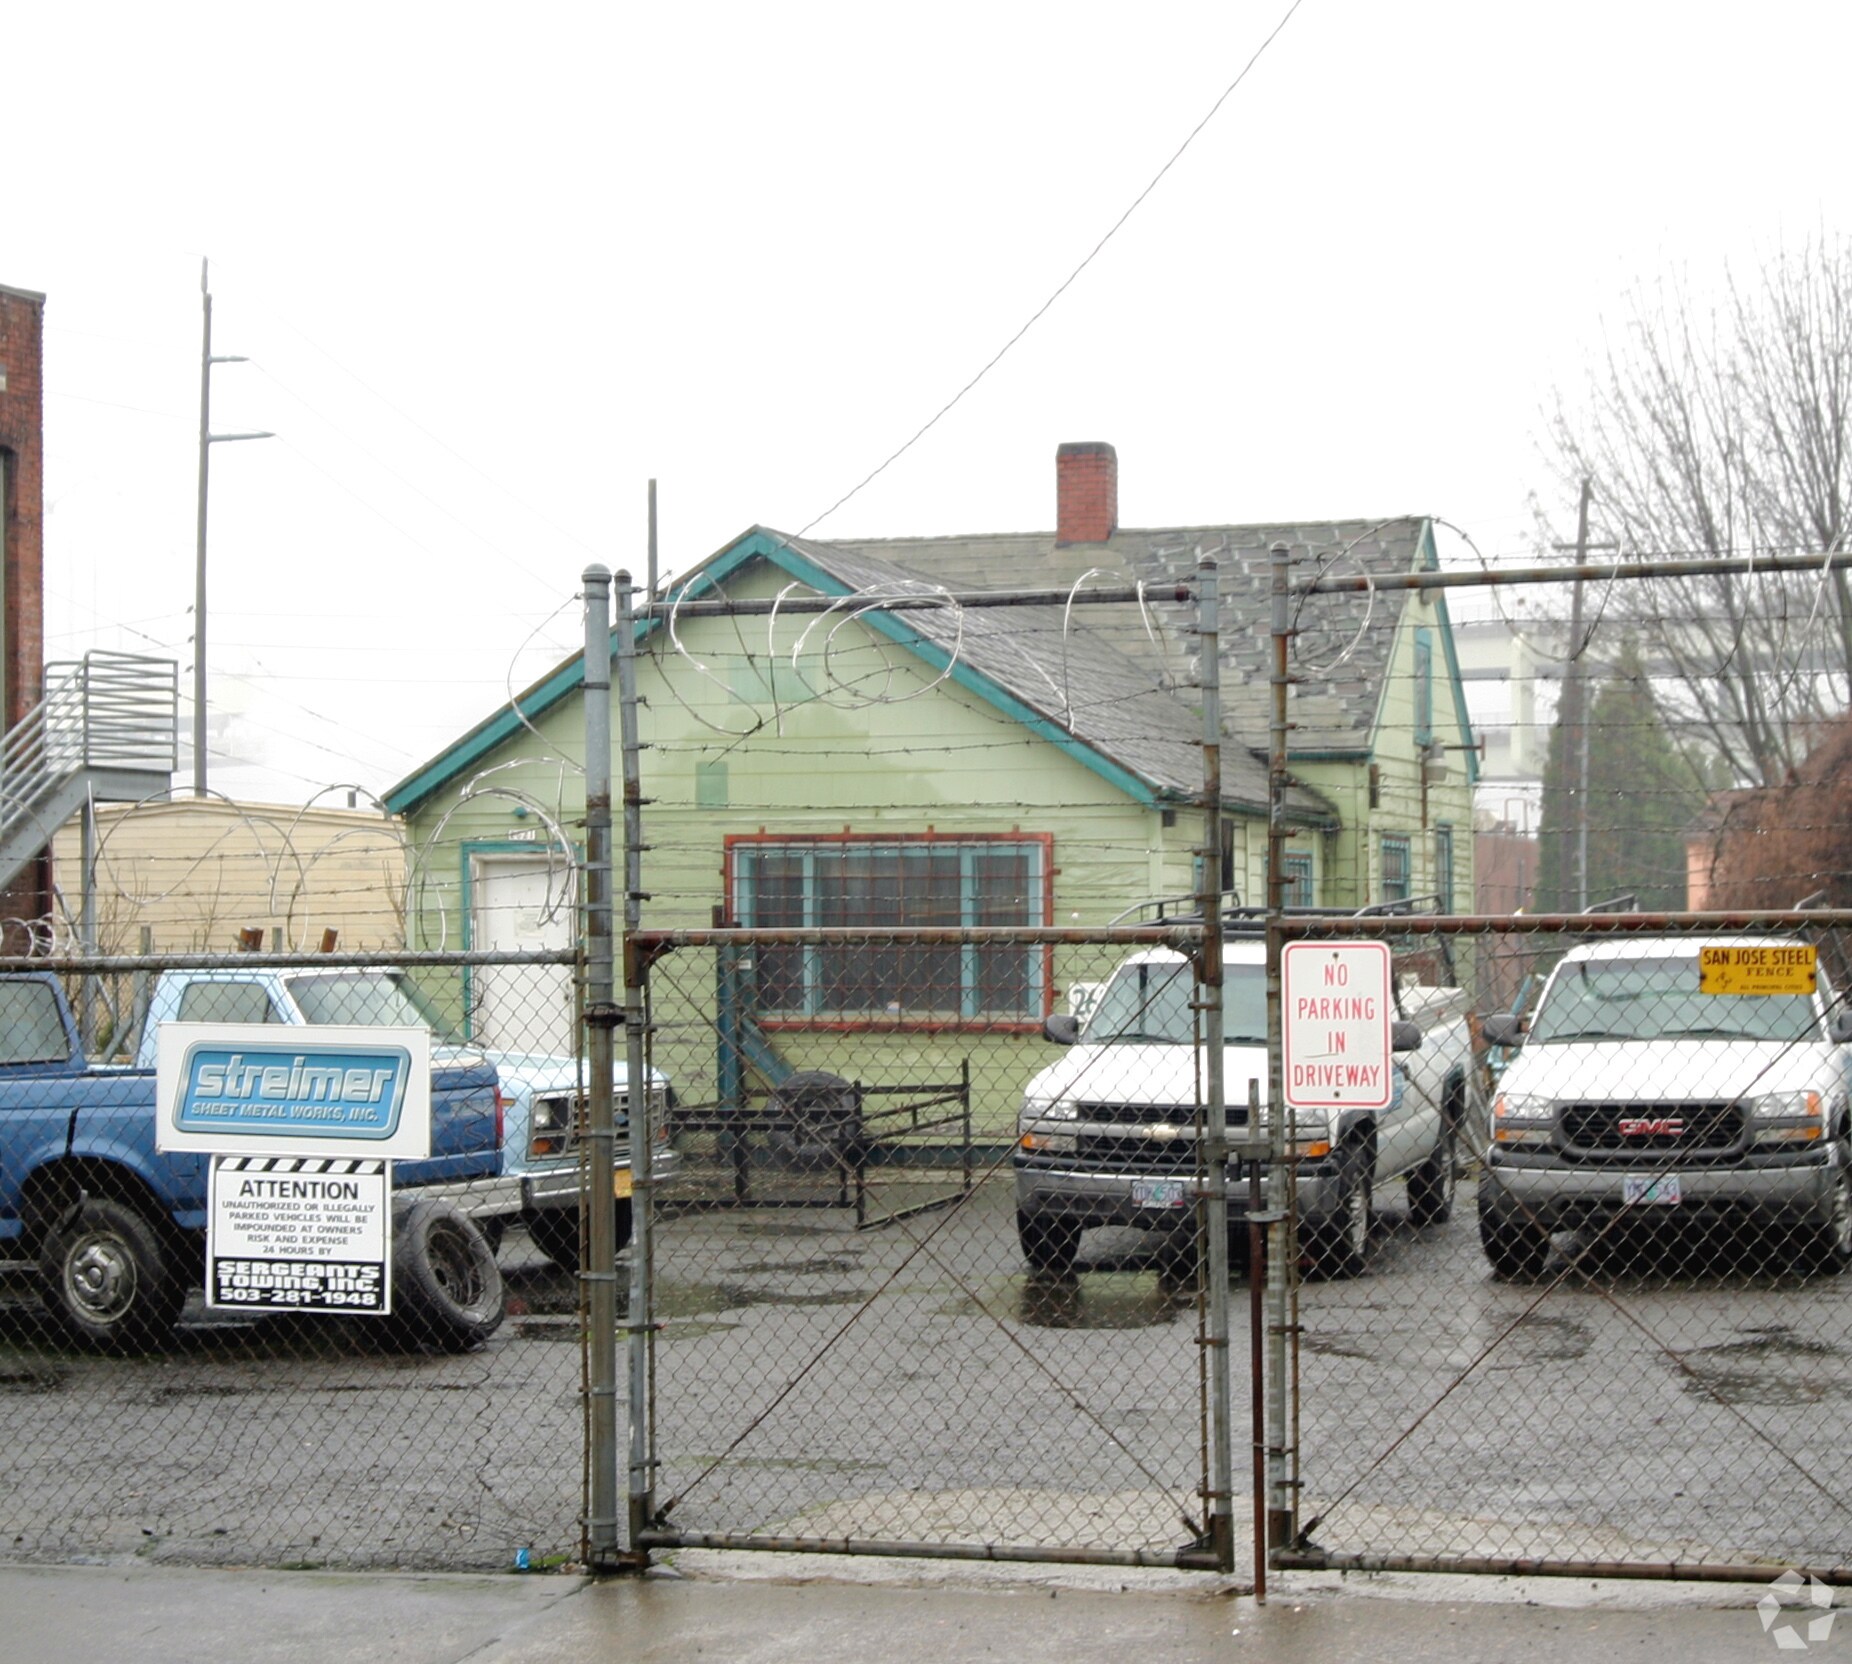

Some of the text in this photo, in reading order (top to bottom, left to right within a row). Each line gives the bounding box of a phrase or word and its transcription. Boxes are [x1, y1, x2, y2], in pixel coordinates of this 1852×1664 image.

[1703, 950, 1812, 966] SAN JOSE STEEL
[1324, 964, 1348, 986] NO
[1746, 967, 1794, 977] FENCE
[1298, 997, 1375, 1020] PARKING
[1328, 1031, 1346, 1053] IN
[194, 1055, 394, 1103] streimer
[1294, 1065, 1381, 1087] DRIVEWAY
[191, 1102, 379, 1123] SHEET METAL WORKS, INC.
[1618, 1118, 1684, 1135] GMC
[239, 1180, 359, 1200] ATTENTION
[222, 1201, 375, 1213] UNAUTHORIZED OR ILLEGALLY
[229, 1212, 368, 1223] PARKED VEHICLES WILL BE
[234, 1223, 363, 1235] IMPOUNDED AT OWNERS
[247, 1234, 348, 1245] RISK AND EXPENSE
[262, 1245, 332, 1255] 24 HOURS BY
[217, 1261, 380, 1279] SERGEANTS
[217, 1274, 380, 1293] TOWING, INC.
[220, 1288, 377, 1306] 503-281-1948
